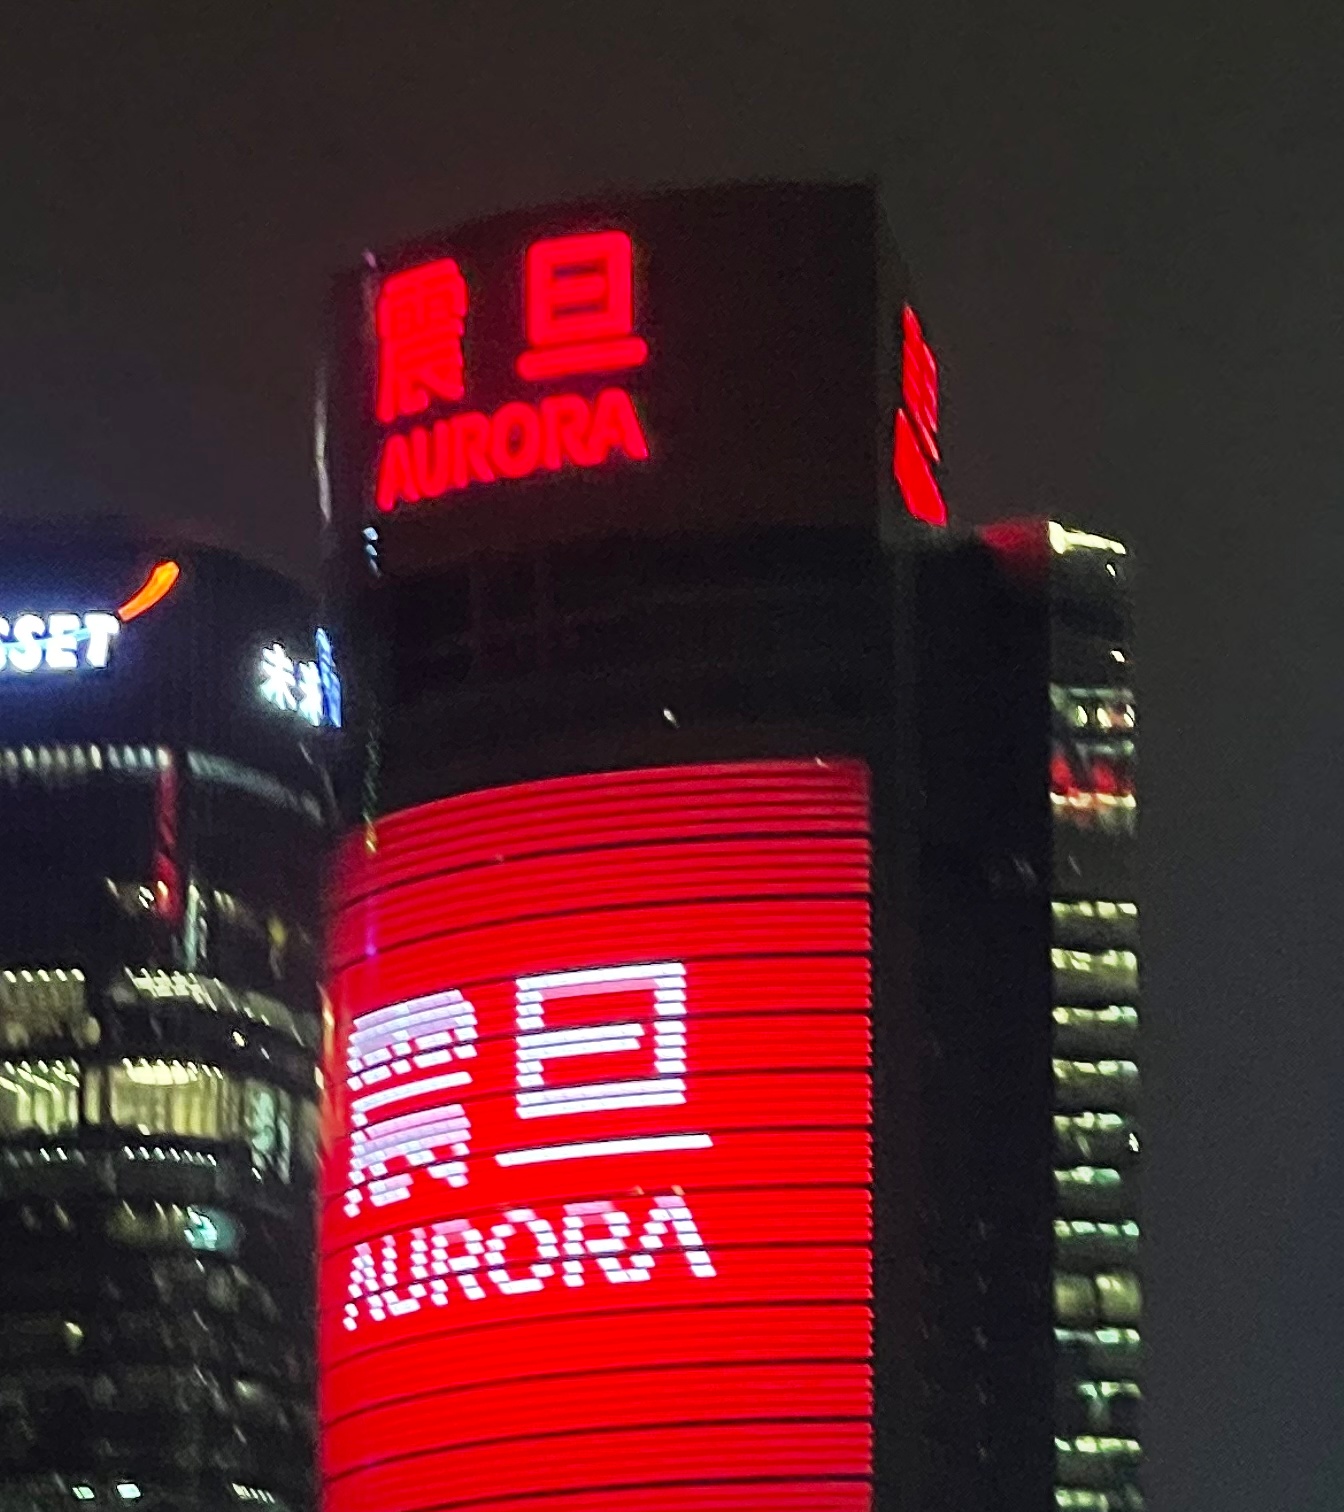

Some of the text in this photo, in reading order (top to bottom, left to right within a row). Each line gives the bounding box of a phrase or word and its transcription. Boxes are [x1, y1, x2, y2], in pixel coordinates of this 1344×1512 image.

[376, 230, 649, 424] 震旦
[376, 388, 649, 513] AURORA
[344, 961, 714, 1218] 震旦
[342, 1195, 718, 1332] AURORA
